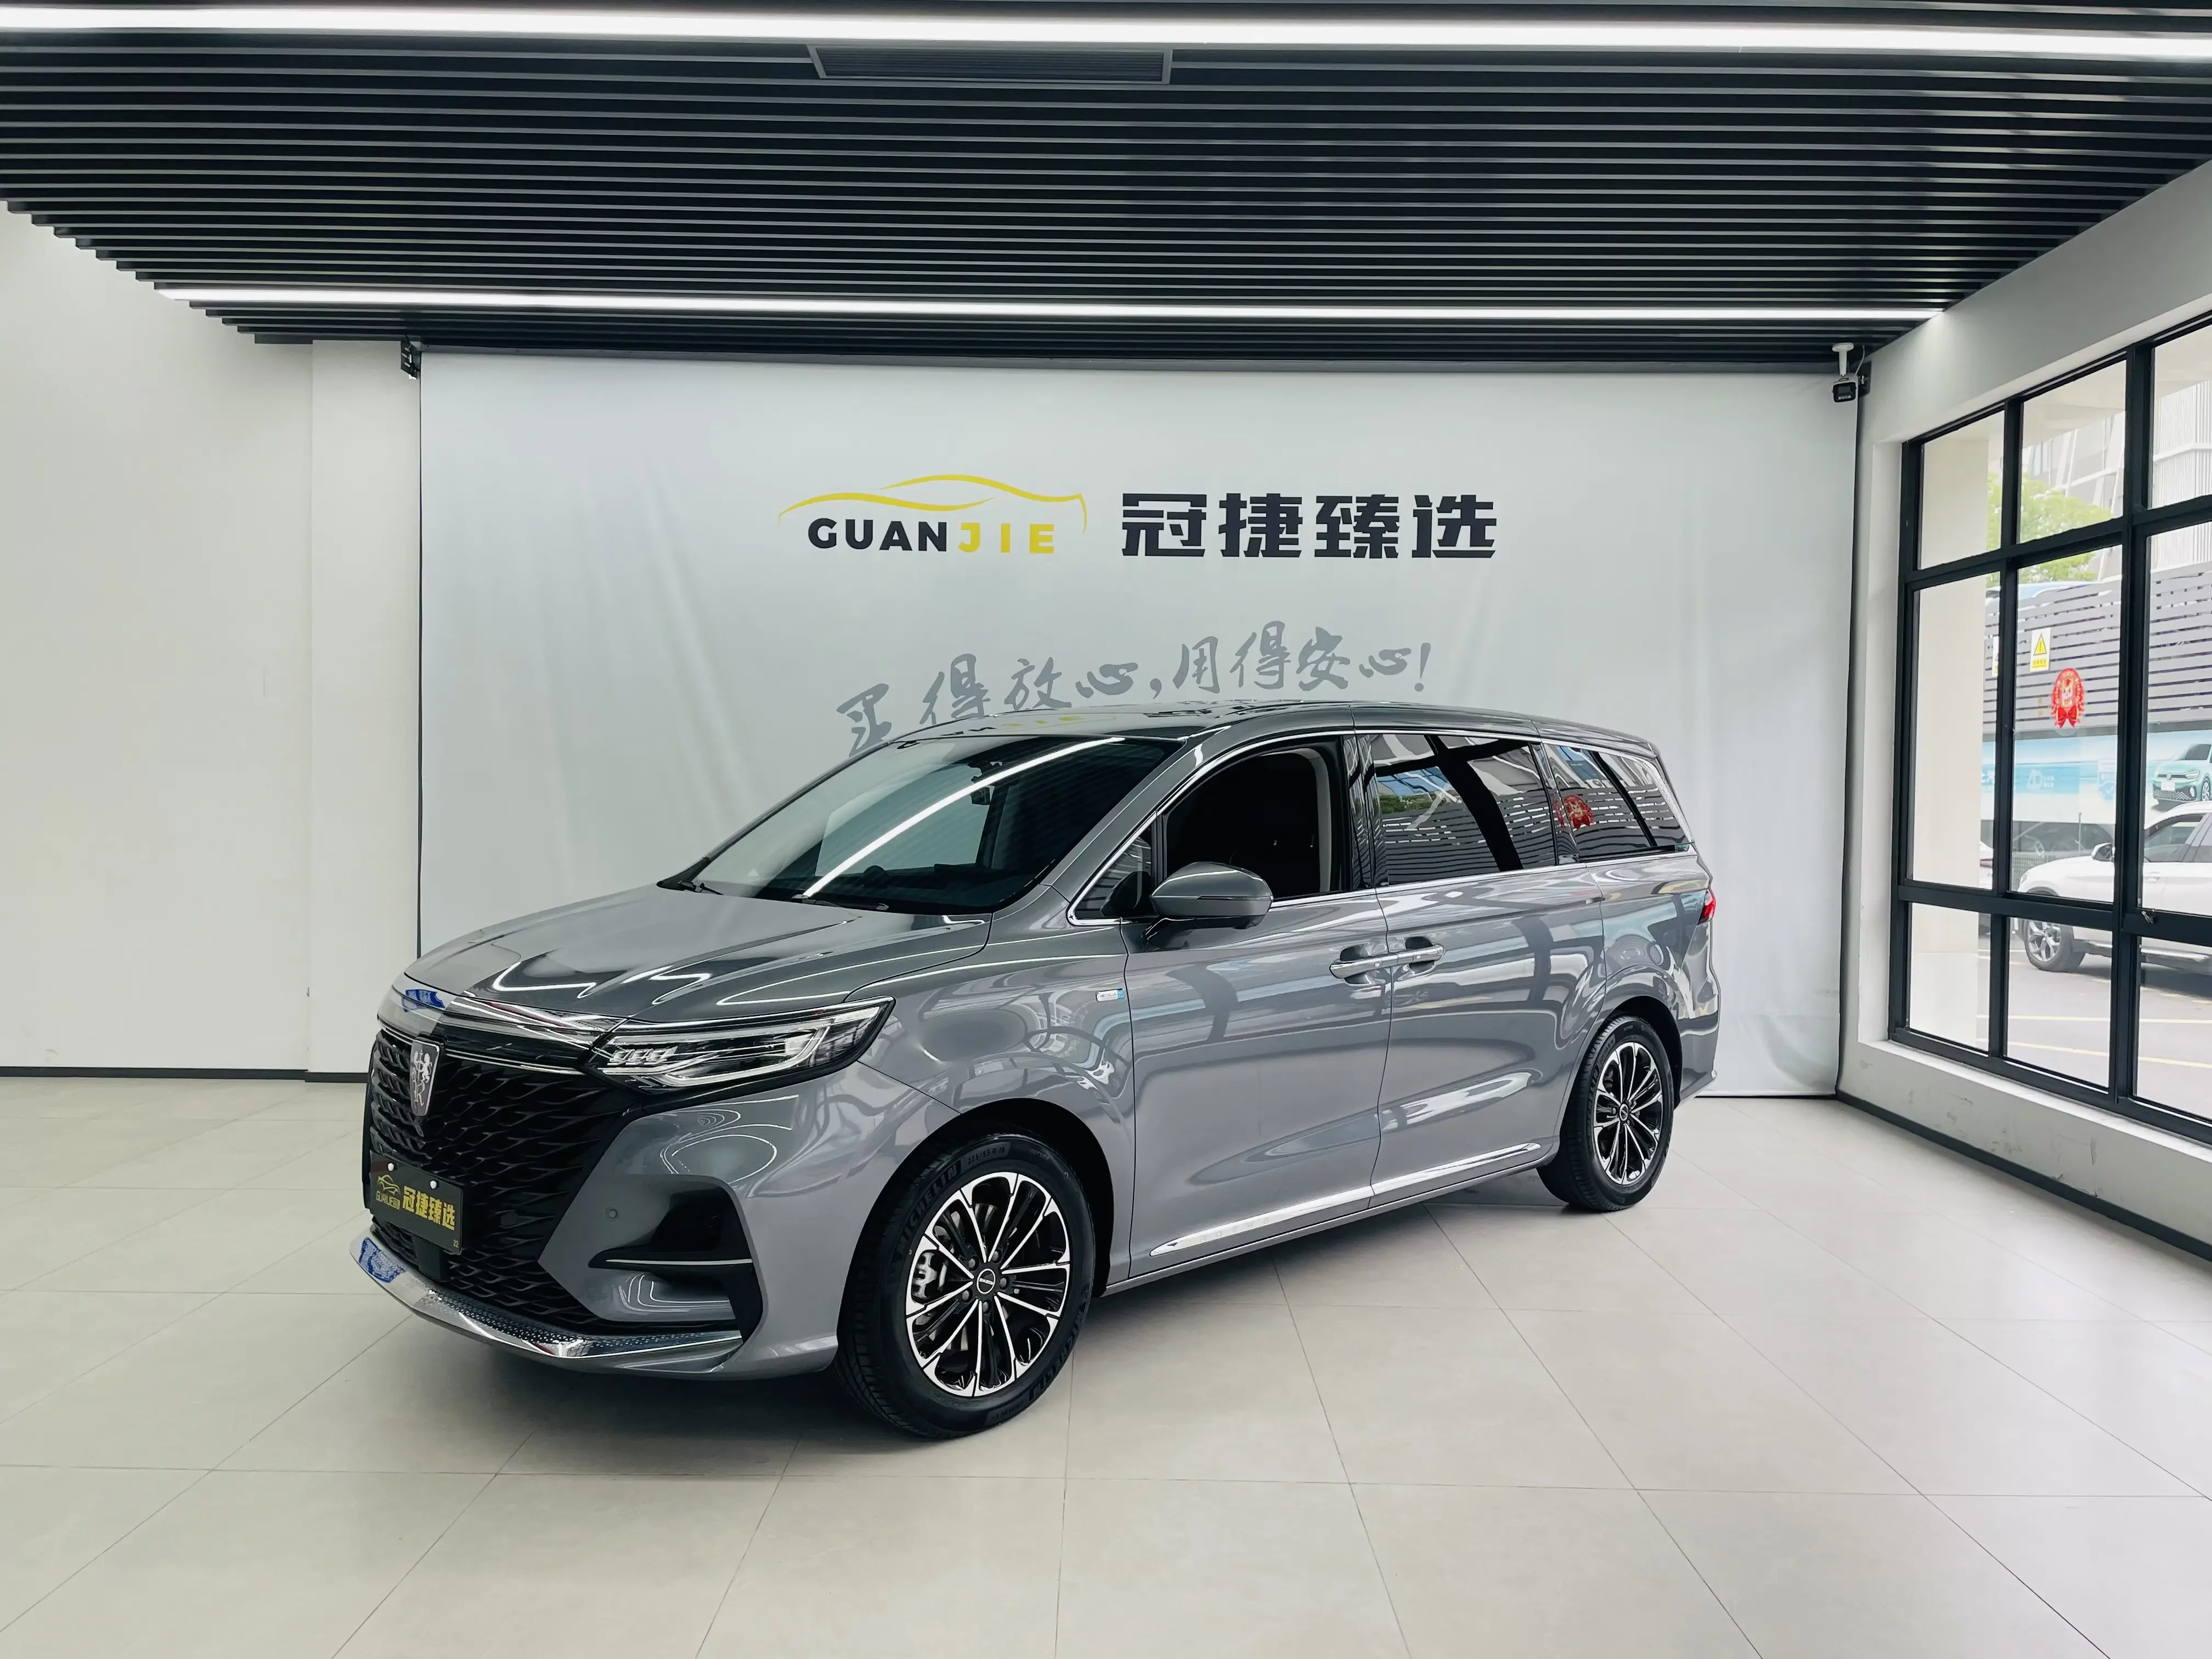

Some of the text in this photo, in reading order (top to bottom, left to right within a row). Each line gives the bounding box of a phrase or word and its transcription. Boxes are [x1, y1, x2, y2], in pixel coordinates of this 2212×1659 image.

[1121, 492, 1498, 559] 冠捷臻选
[402, 1186, 455, 1231] 冠捷臻选
[896, 1164, 957, 1255] MICHELIN
